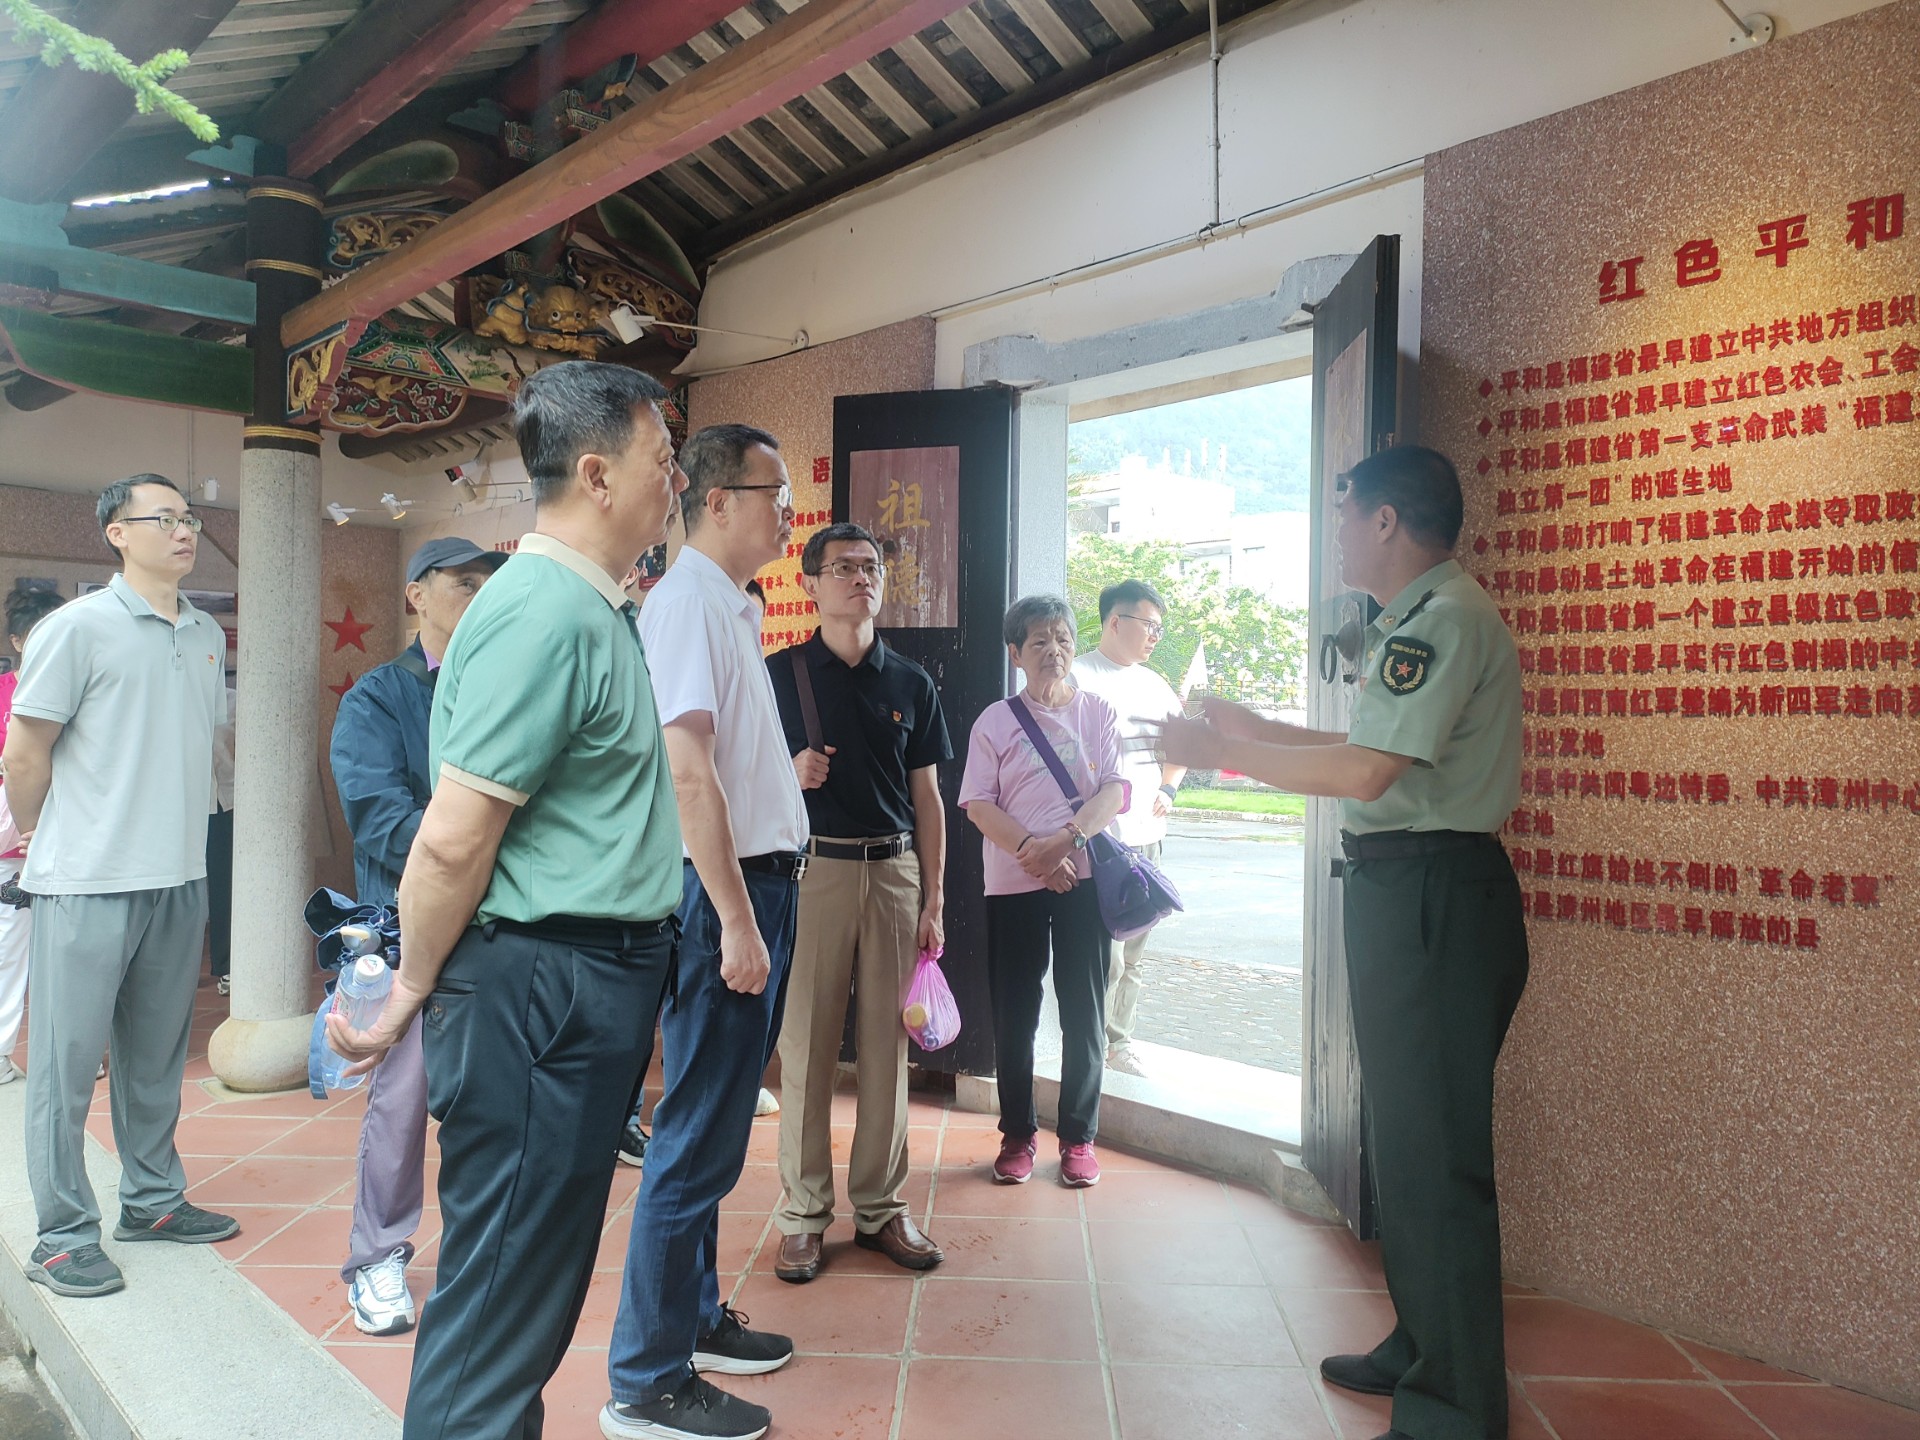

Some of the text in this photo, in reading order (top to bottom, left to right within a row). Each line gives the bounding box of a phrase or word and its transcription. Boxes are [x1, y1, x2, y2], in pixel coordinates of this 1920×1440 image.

[1599, 194, 1905, 304] 红色平和
[1499, 389, 1920, 476] 平和是福建省第一支革命武装“福建
[812, 456, 831, 484] 语
[1495, 488, 1920, 558] 平和暴动打响了福建革命武装夺取政
[1499, 587, 1920, 634] 和是福建省第一个建立县级红色政
[1504, 807, 1554, 837] 在地
